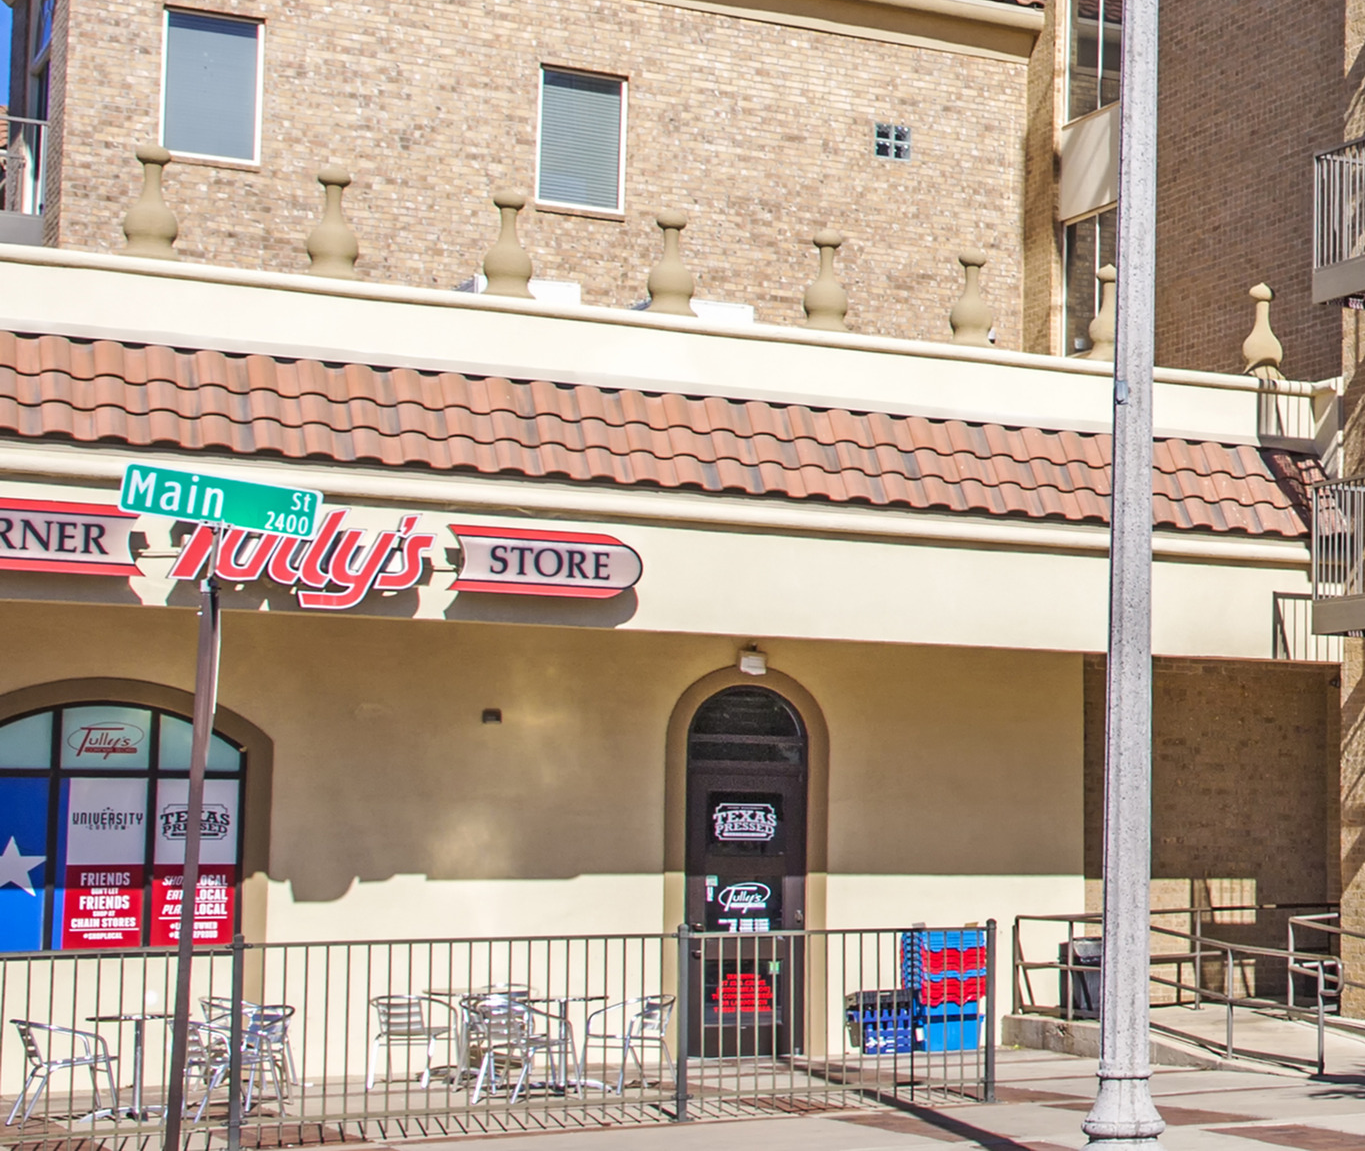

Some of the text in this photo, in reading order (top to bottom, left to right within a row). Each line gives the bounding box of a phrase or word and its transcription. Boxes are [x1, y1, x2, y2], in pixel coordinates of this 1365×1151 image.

[126, 469, 312, 519] Main St
[264, 510, 309, 535] 2400
[0, 517, 109, 555] RNER
[489, 545, 611, 581] STORE
[76, 727, 131, 760] Tully's
[72, 812, 144, 825] UNIVERSITY
[160, 810, 230, 826] TEAS
[712, 810, 777, 827] TEXAS
[162, 822, 228, 834] PRSED
[715, 822, 775, 834] PRESSED
[81, 872, 130, 886] FRIENDS
[162, 876, 184, 886] SHO
[79, 895, 130, 910] FRIENDS
[724, 887, 763, 914] Tully's
[162, 903, 228, 915] PLA LOCAL
[71, 917, 136, 928] CHAIN STORES
